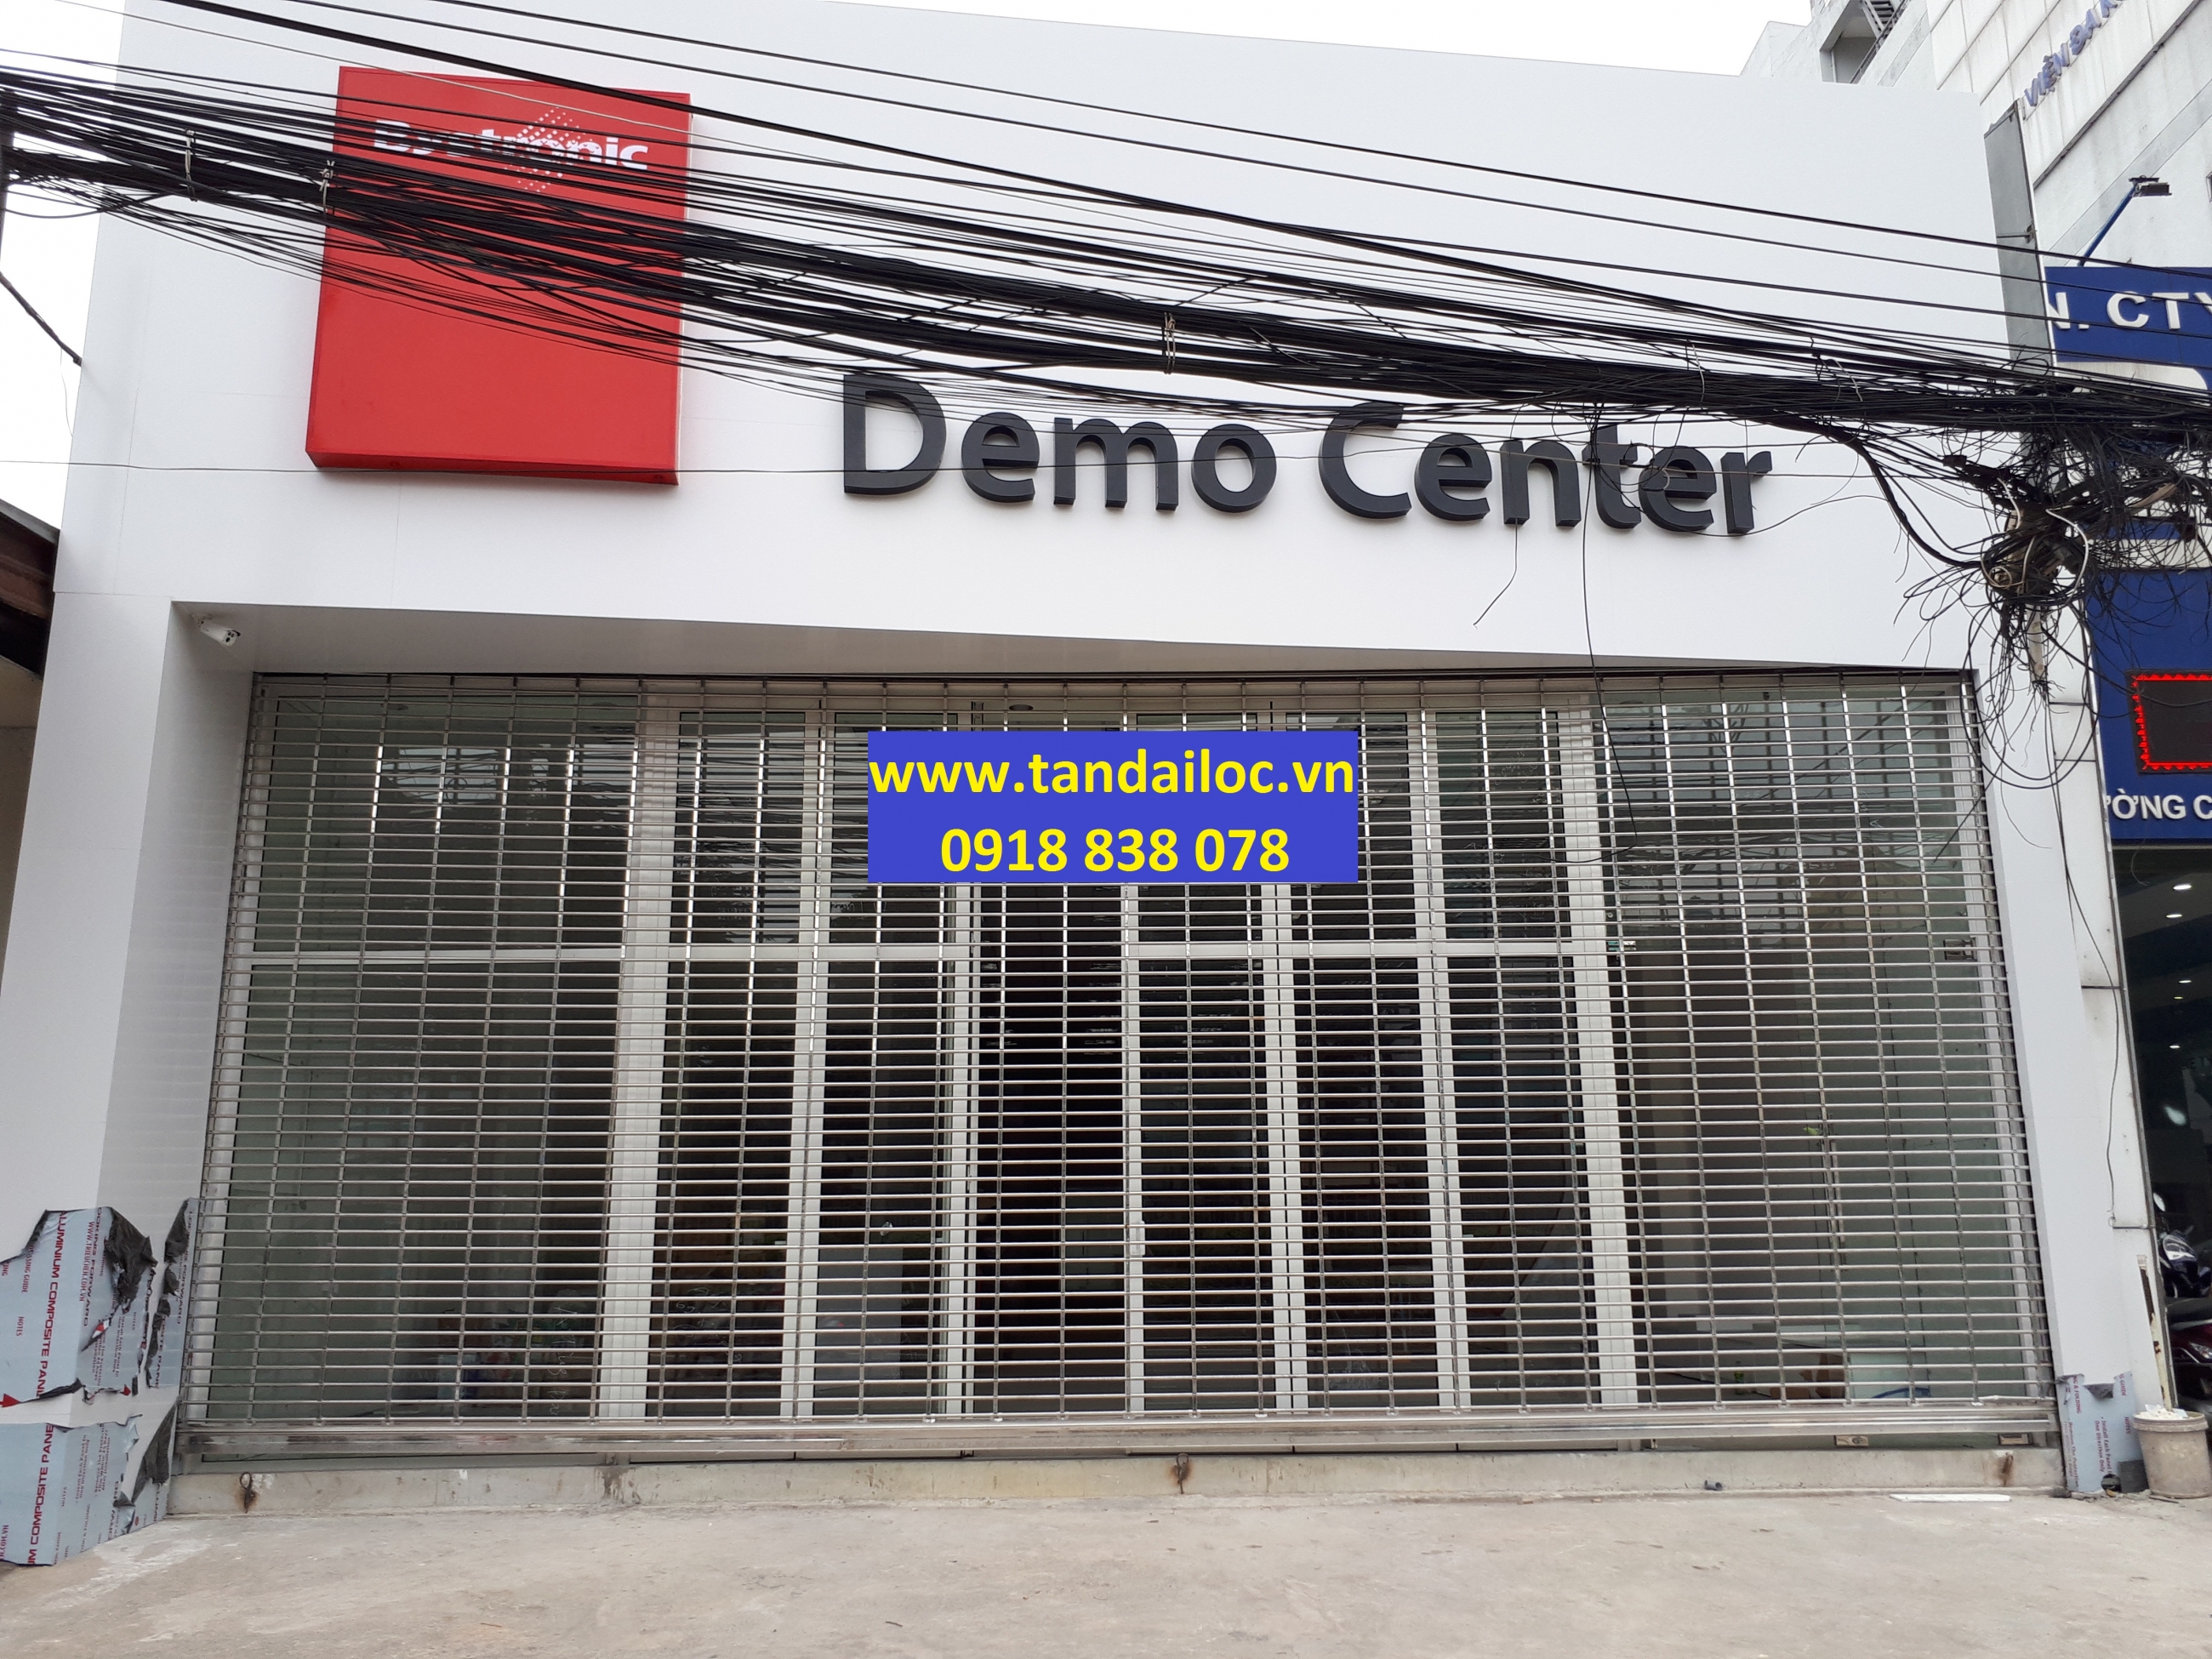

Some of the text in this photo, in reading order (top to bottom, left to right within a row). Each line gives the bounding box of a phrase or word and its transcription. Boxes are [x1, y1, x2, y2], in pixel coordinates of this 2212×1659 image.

[841, 372, 1774, 536] Demo Center
[16, 1316, 25, 1337] NOTES
[42, 1281, 59, 1357] COMPOSITE
[30, 1467, 48, 1545] COMPOSITE
